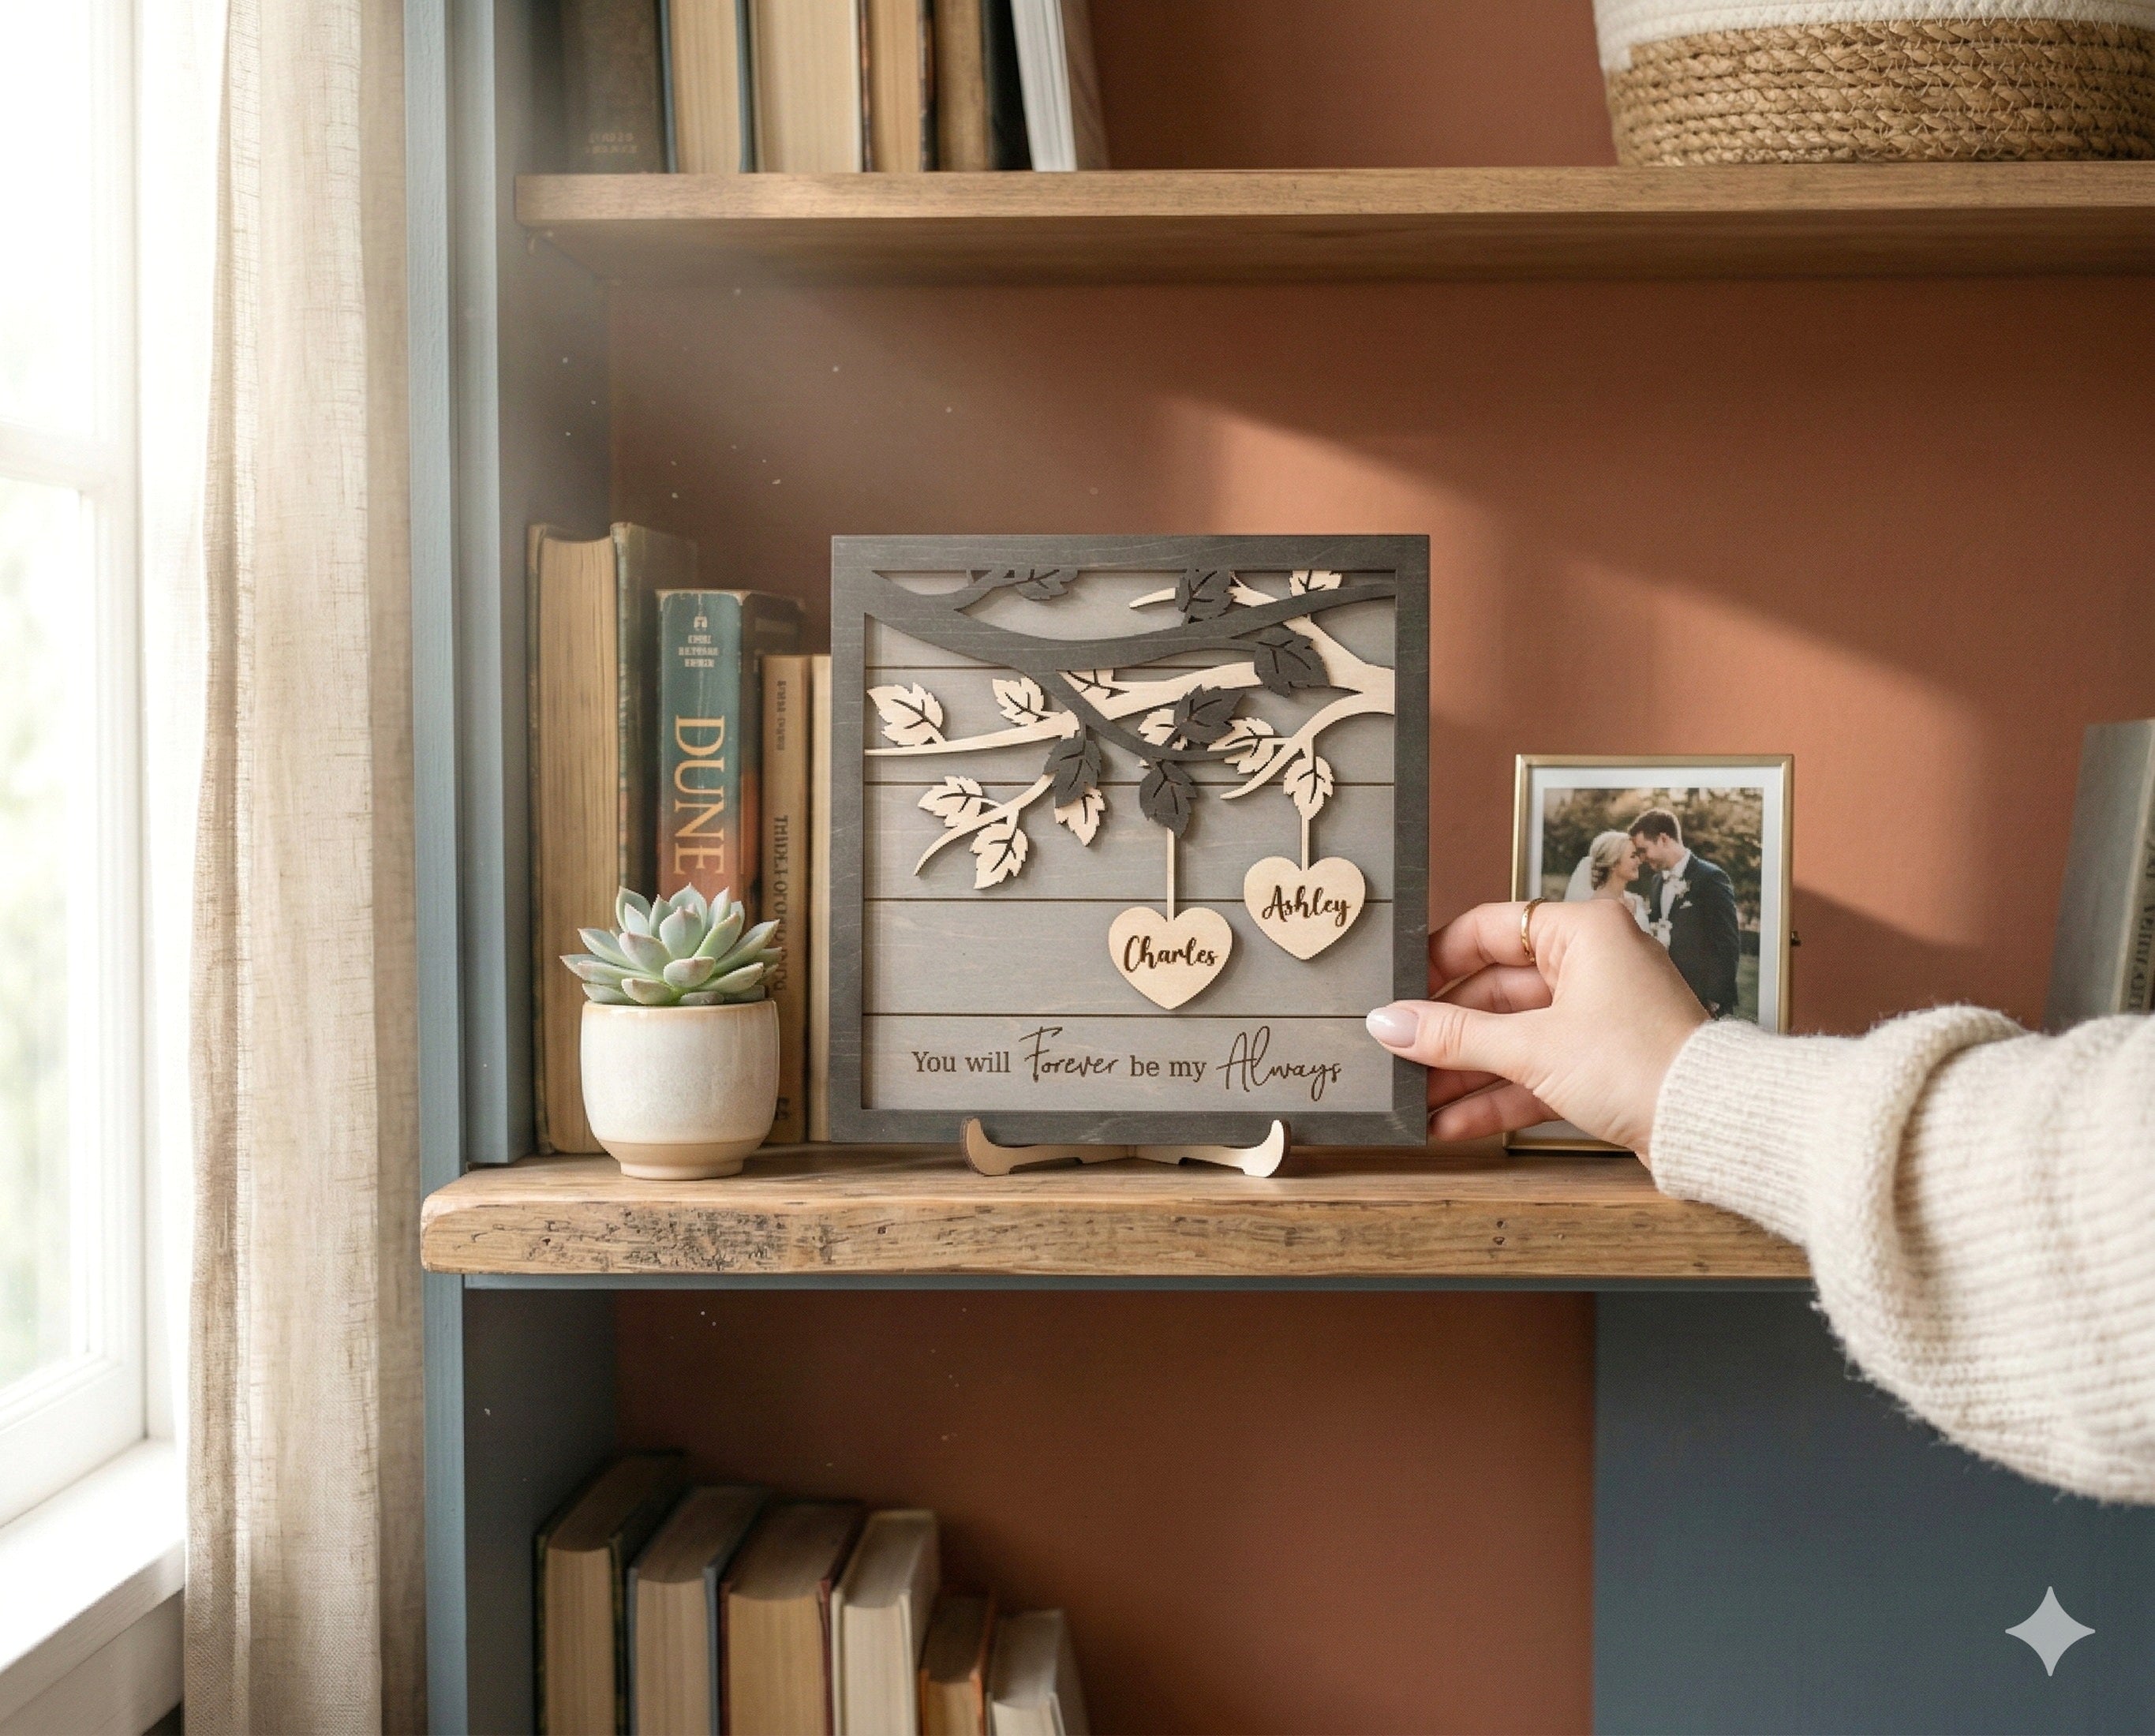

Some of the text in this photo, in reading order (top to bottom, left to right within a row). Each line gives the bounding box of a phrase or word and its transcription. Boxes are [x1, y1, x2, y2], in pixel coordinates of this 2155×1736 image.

[674, 715, 725, 875] DUNE
[1263, 885, 1351, 927] Ashley
[1124, 935, 1218, 972] Charles
[911, 1025, 1342, 1102] You will Forever be my Always
